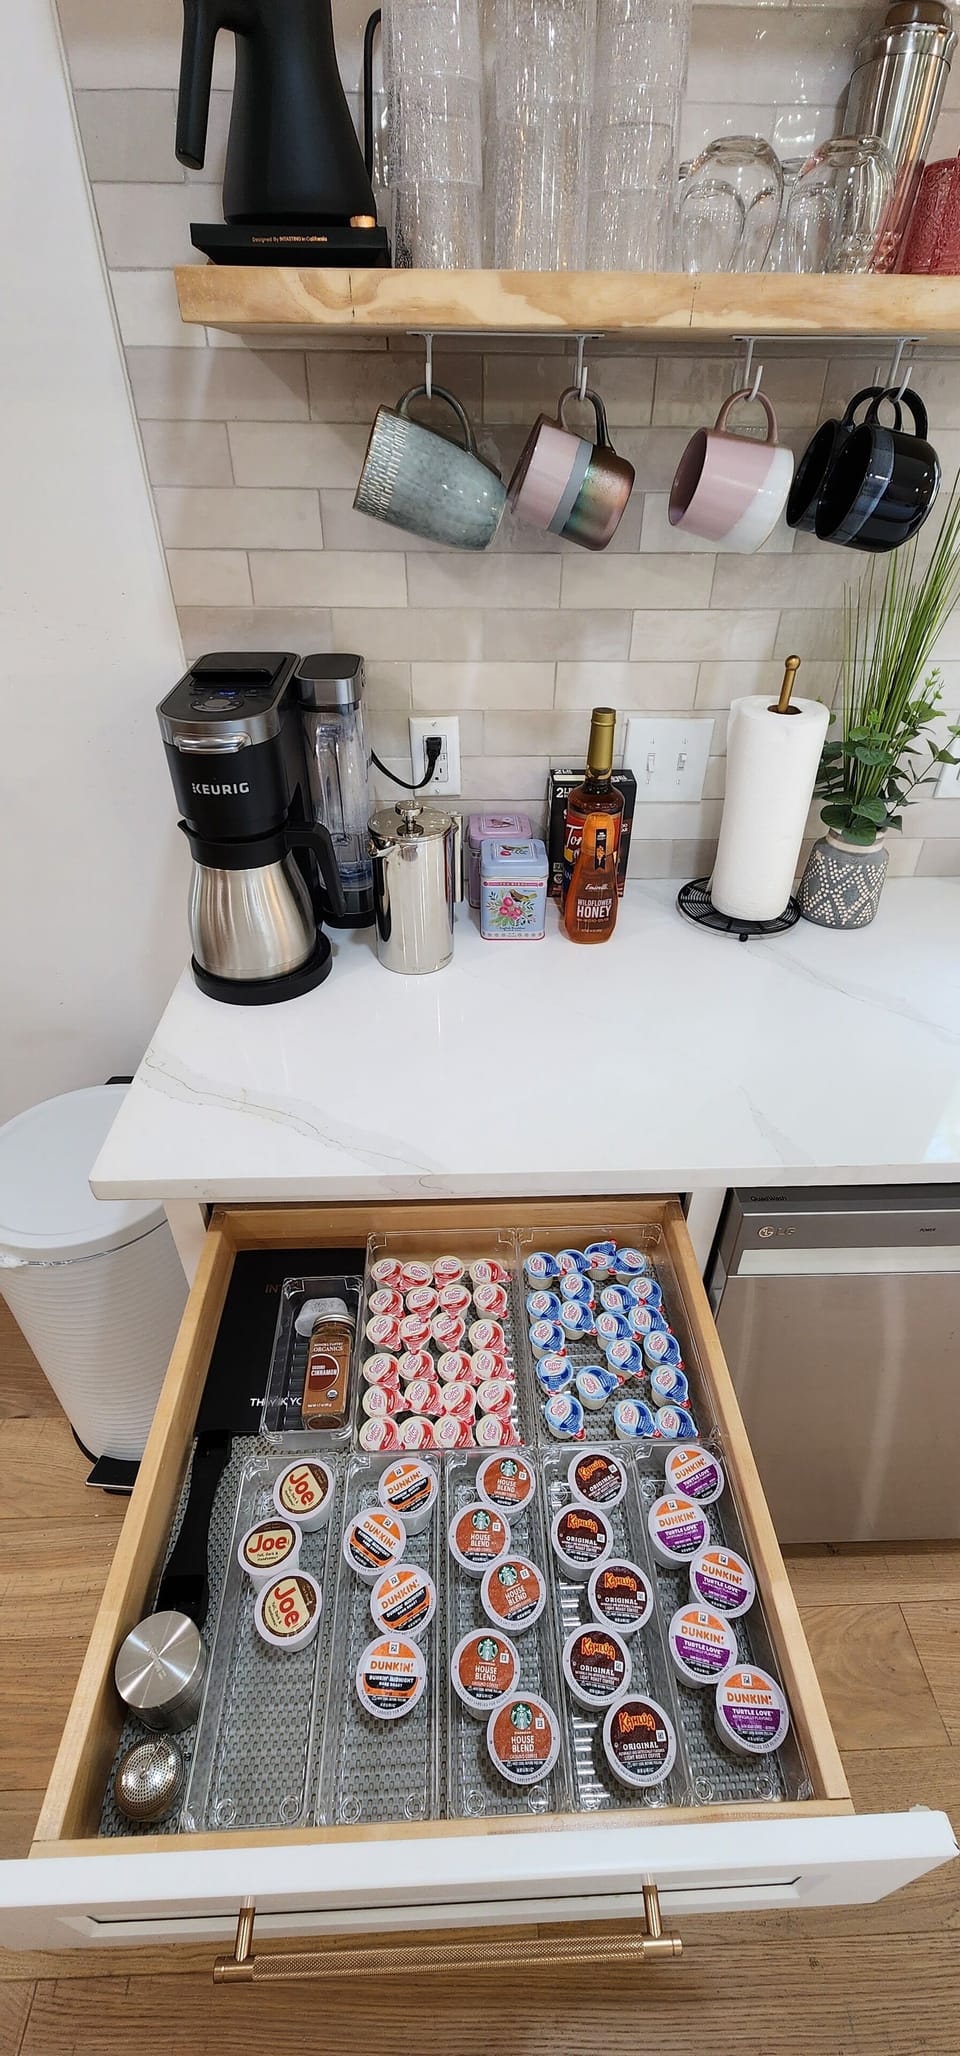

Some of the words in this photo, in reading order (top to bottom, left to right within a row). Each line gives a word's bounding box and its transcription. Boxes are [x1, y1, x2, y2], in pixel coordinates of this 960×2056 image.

[191, 782, 250, 795] KEURIG
[556, 787, 564, 798] 2
[577, 898, 612, 906] WILDFLOWER
[576, 905, 612, 919] HONEY
[313, 1345, 344, 1353] ORGANICS
[497, 1479, 517, 1488] HOUSE
[589, 1474, 615, 1492] ORIGINAL
[683, 1474, 700, 1486] TURTLE
[289, 1472, 315, 1505] Joe
[497, 1485, 516, 1493] BLEND
[470, 1533, 491, 1541] HOUSE
[665, 1527, 684, 1537] TURTLE
[248, 1534, 287, 1553] Joe
[566, 1535, 598, 1546] ORIGINAL
[703, 1577, 724, 1588] TURTLE
[505, 1585, 526, 1600] HOUSE
[508, 1592, 528, 1607] BLEND
[604, 1596, 639, 1605] ORIGINAL
[274, 1587, 300, 1628] Joe
[684, 1640, 706, 1651] TURTLE
[475, 1666, 497, 1675] HOUSE
[580, 1664, 615, 1676] ORIGINAL
[475, 1673, 497, 1682] BLEND
[732, 1708, 755, 1716] TURTLE
[511, 1735, 535, 1744] HOUSE
[512, 1744, 535, 1753] BLEND
[622, 1741, 659, 1751] ORIGINAL
